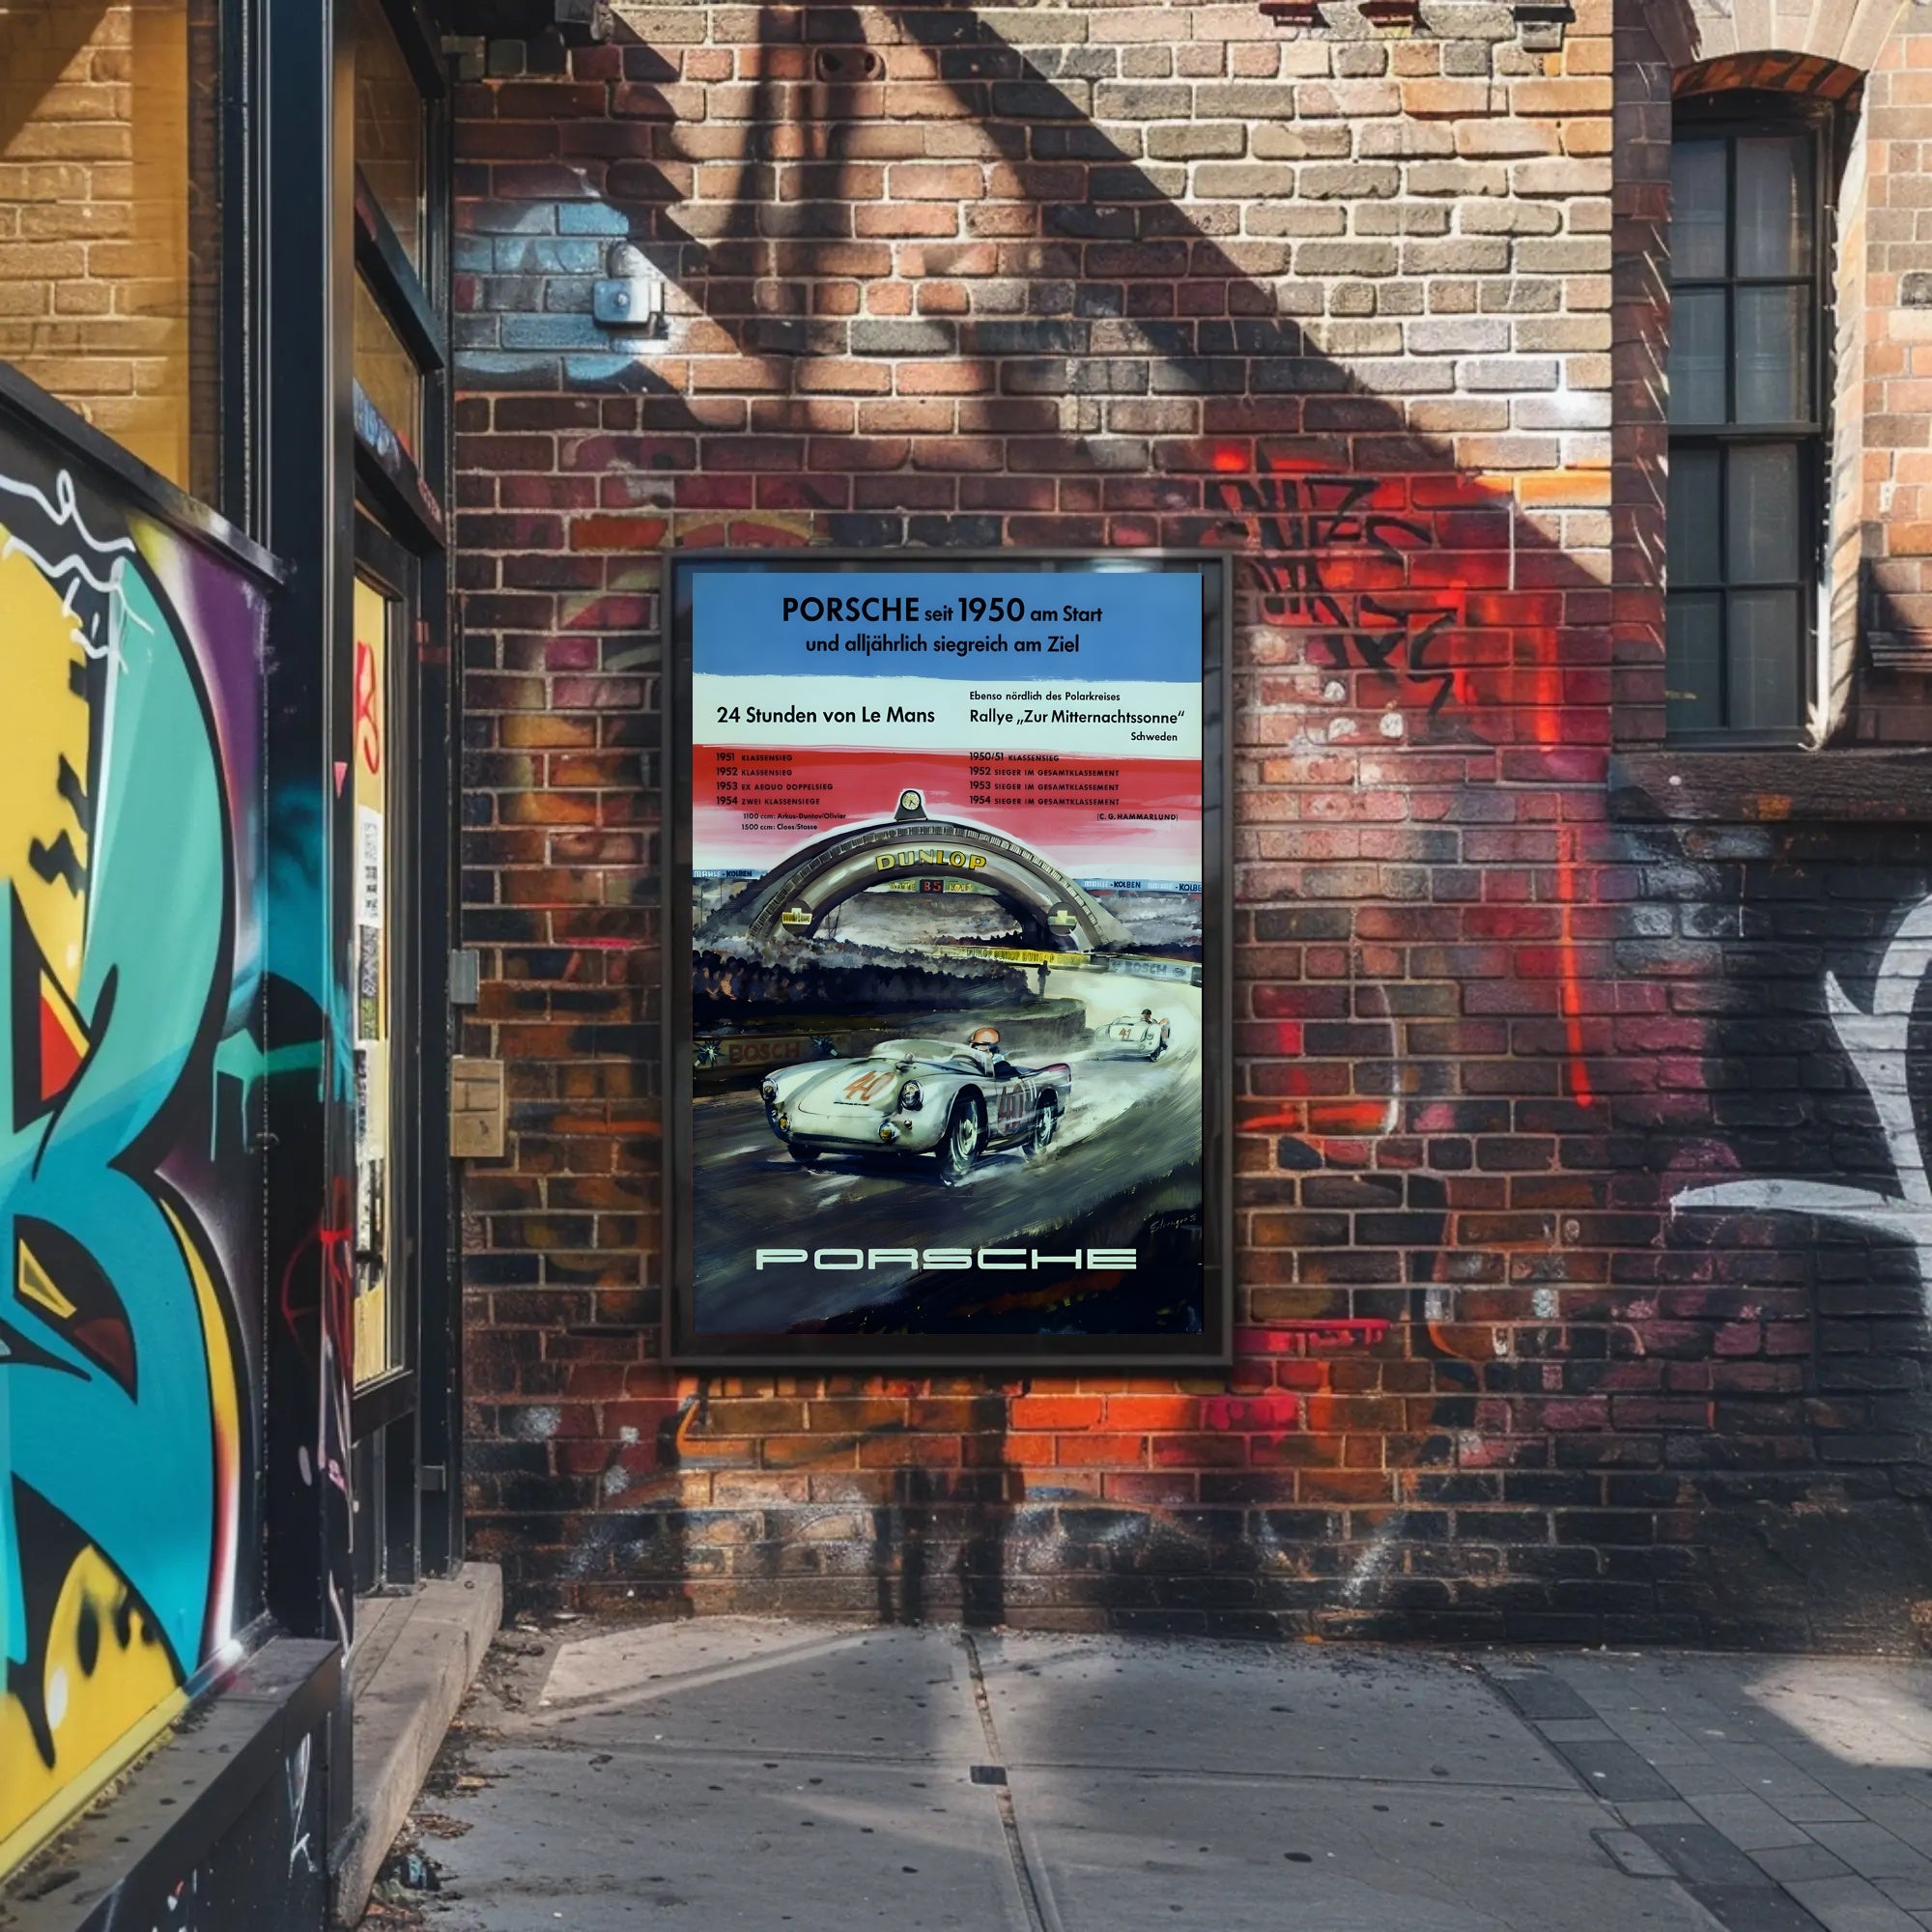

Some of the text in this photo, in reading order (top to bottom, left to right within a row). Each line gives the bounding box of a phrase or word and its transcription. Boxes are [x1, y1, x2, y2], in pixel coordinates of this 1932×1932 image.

[782, 596, 1103, 622] PORSCHE seit 1950 am Start
[806, 633, 1080, 658] und alljährlich siegreich am Ziel
[969, 690, 1121, 701] Ebenso nördlich des Polarkreises
[717, 705, 935, 724] 24 Stunden von Le Mans
[970, 708, 1013, 725] Rallye
[1130, 730, 1178, 742] Schweden
[716, 752, 735, 762] 1951
[969, 751, 1060, 763] 1950/51 KLASSENSIEG
[716, 766, 738, 777] 1952
[969, 765, 992, 776] 1952
[994, 768, 1022, 777] SIEGER
[1024, 768, 1035, 777] IM
[716, 781, 738, 791] 1953
[969, 780, 992, 790] 1953
[994, 782, 1022, 791] SIEGER
[1024, 782, 1035, 791] IM
[716, 795, 739, 806] 1954
[969, 794, 992, 805] 1954
[994, 797, 1022, 806] SIEGER
[1024, 797, 1035, 806] IM
[875, 849, 987, 871] DUNLOP
[728, 1042, 800, 1063] BOSCH
[755, 1248, 1137, 1270] PORSCHE
